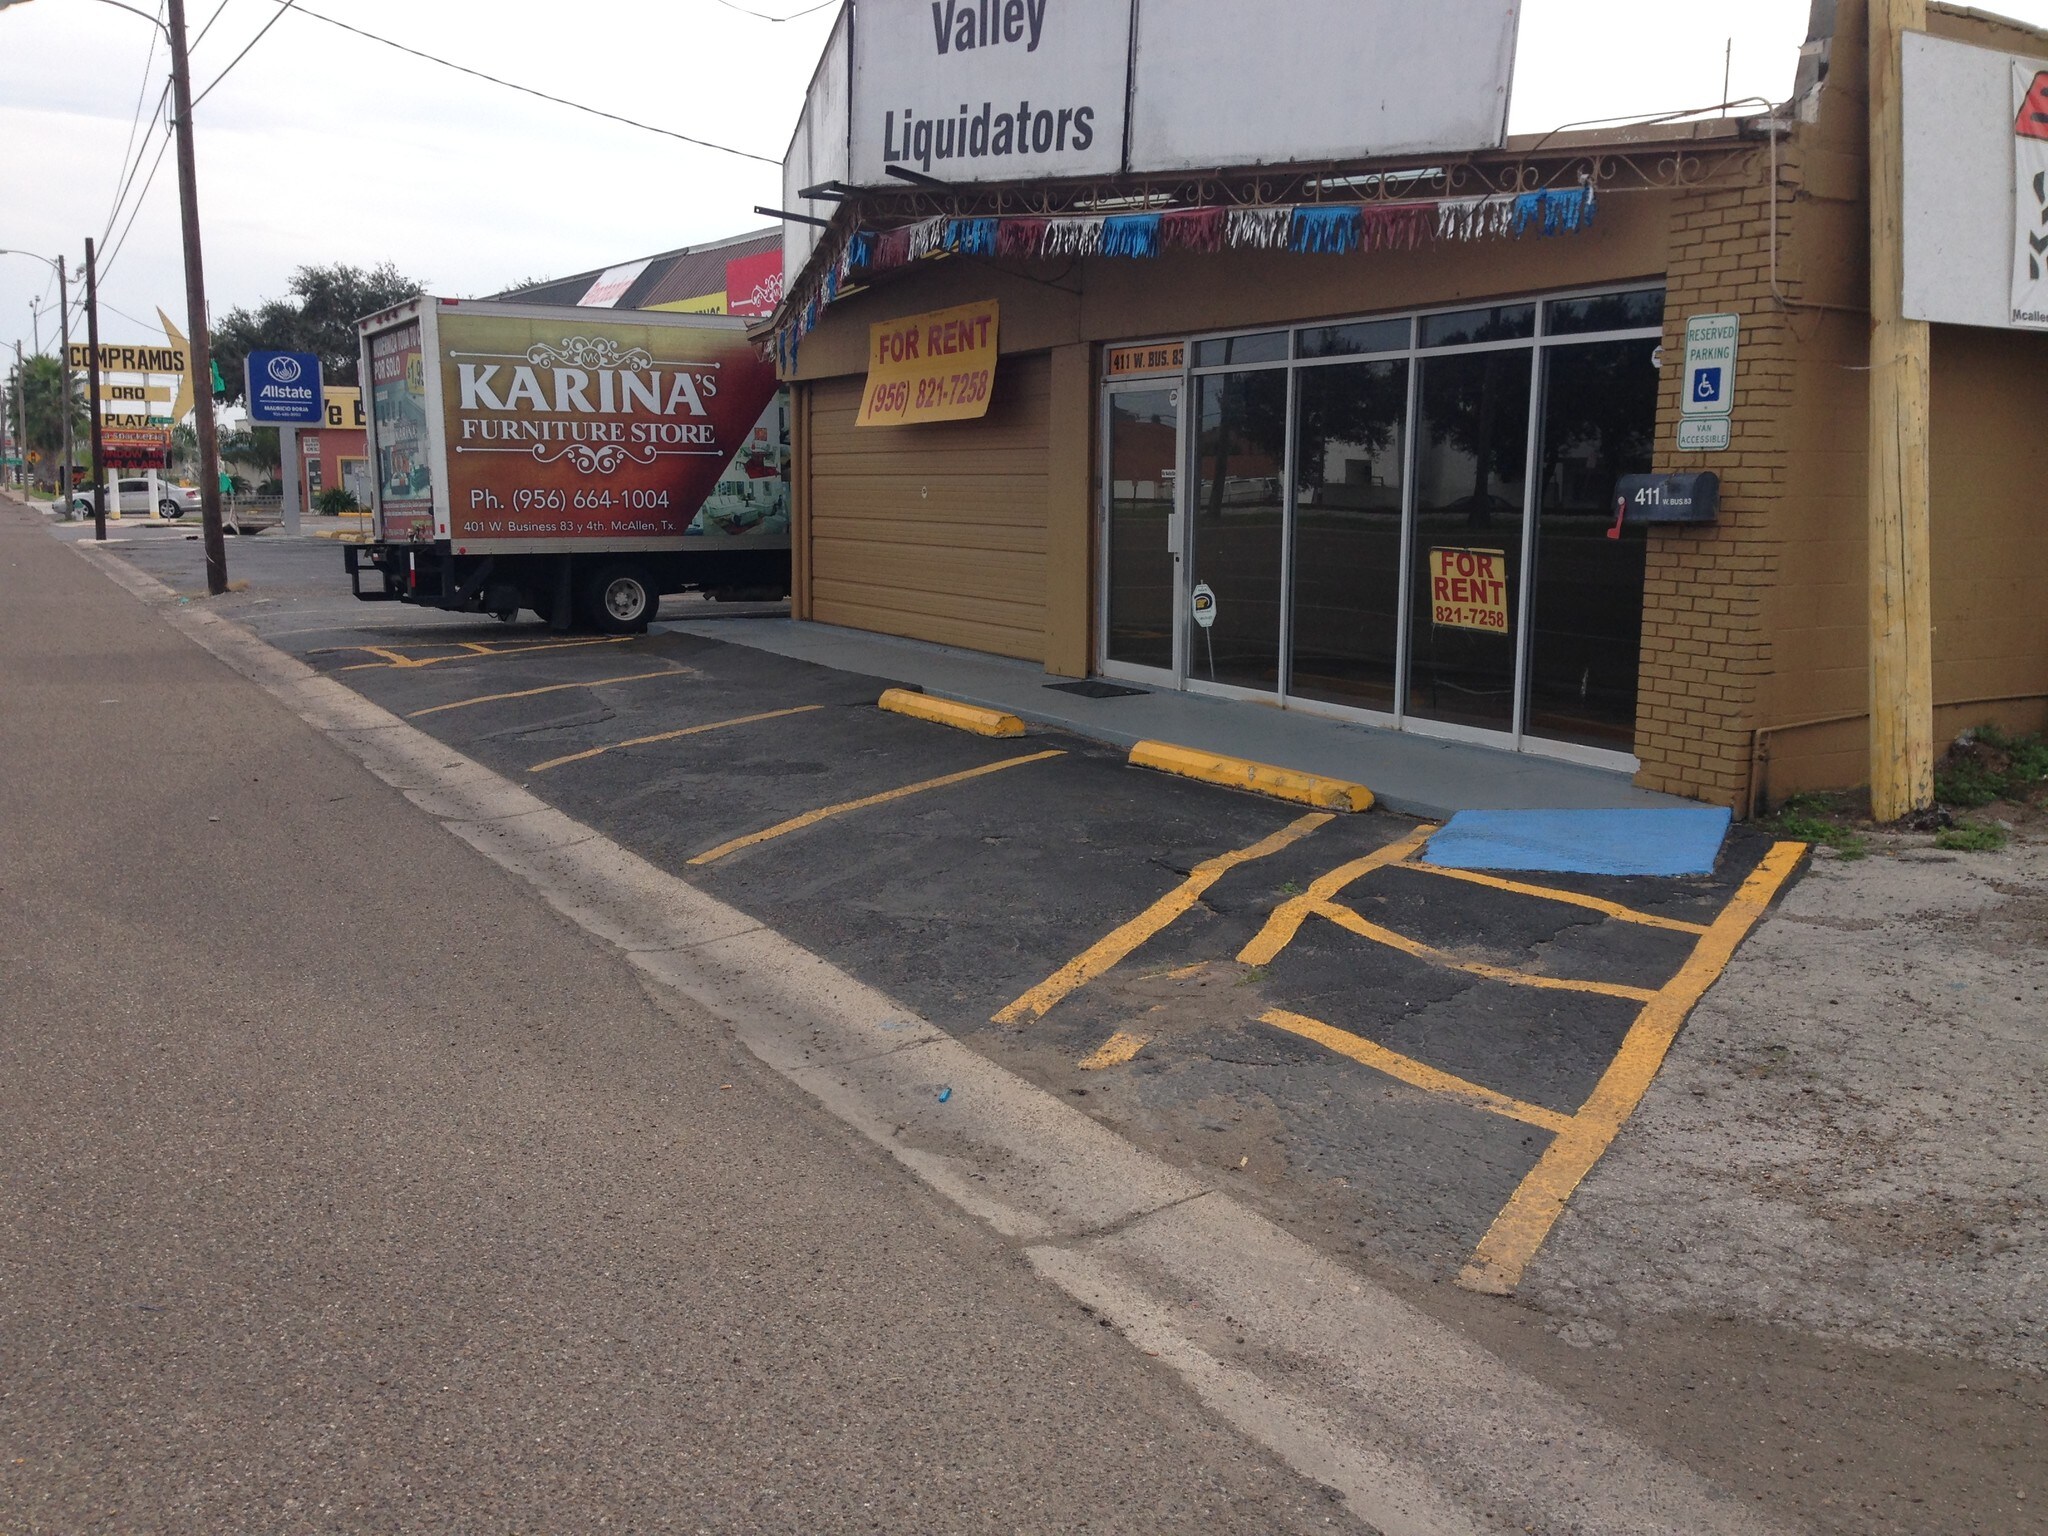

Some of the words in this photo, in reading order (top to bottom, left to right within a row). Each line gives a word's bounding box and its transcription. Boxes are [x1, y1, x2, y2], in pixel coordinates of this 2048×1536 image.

[931, 0, 1047, 56] Valley
[883, 100, 1095, 173] Liquidators
[2012, 308, 2048, 323] Mcalle
[879, 327, 920, 365] FOR
[927, 314, 992, 358] RENT
[1688, 325, 1735, 342] RESERVED
[1113, 353, 1130, 370] 411
[1133, 352, 1145, 369] W.
[1147, 350, 1170, 368] BUS.
[1172, 348, 1184, 365] 83
[1690, 346, 1730, 361] PARKING
[112, 386, 146, 400] ORO
[260, 384, 312, 399] Allstate
[456, 363, 717, 416] KARINA'S
[867, 380, 910, 420] (956)
[915, 369, 989, 409] 821-7258
[105, 414, 156, 427] PLATA
[461, 419, 626, 442] FURNITURE
[630, 422, 716, 444] STORE
[1697, 424, 1712, 432] VAN
[1681, 434, 1726, 444] ACCESSIBLE
[470, 489, 505, 509] Ph.
[512, 489, 567, 512] (956)
[573, 489, 670, 509] 664-1004
[1634, 487, 1660, 506] 411
[463, 521, 485, 532] 401
[489, 521, 504, 532] W.
[508, 521, 557, 532] Business
[560, 521, 574, 531] 83
[577, 523, 583, 533] y
[586, 520, 608, 531] 4th.
[611, 519, 658, 532] McAllen,
[661, 519, 677, 531] Tx.
[1441, 550, 1495, 579] FOR
[1434, 576, 1504, 606] RENT
[1435, 605, 1505, 628] 821-7258
